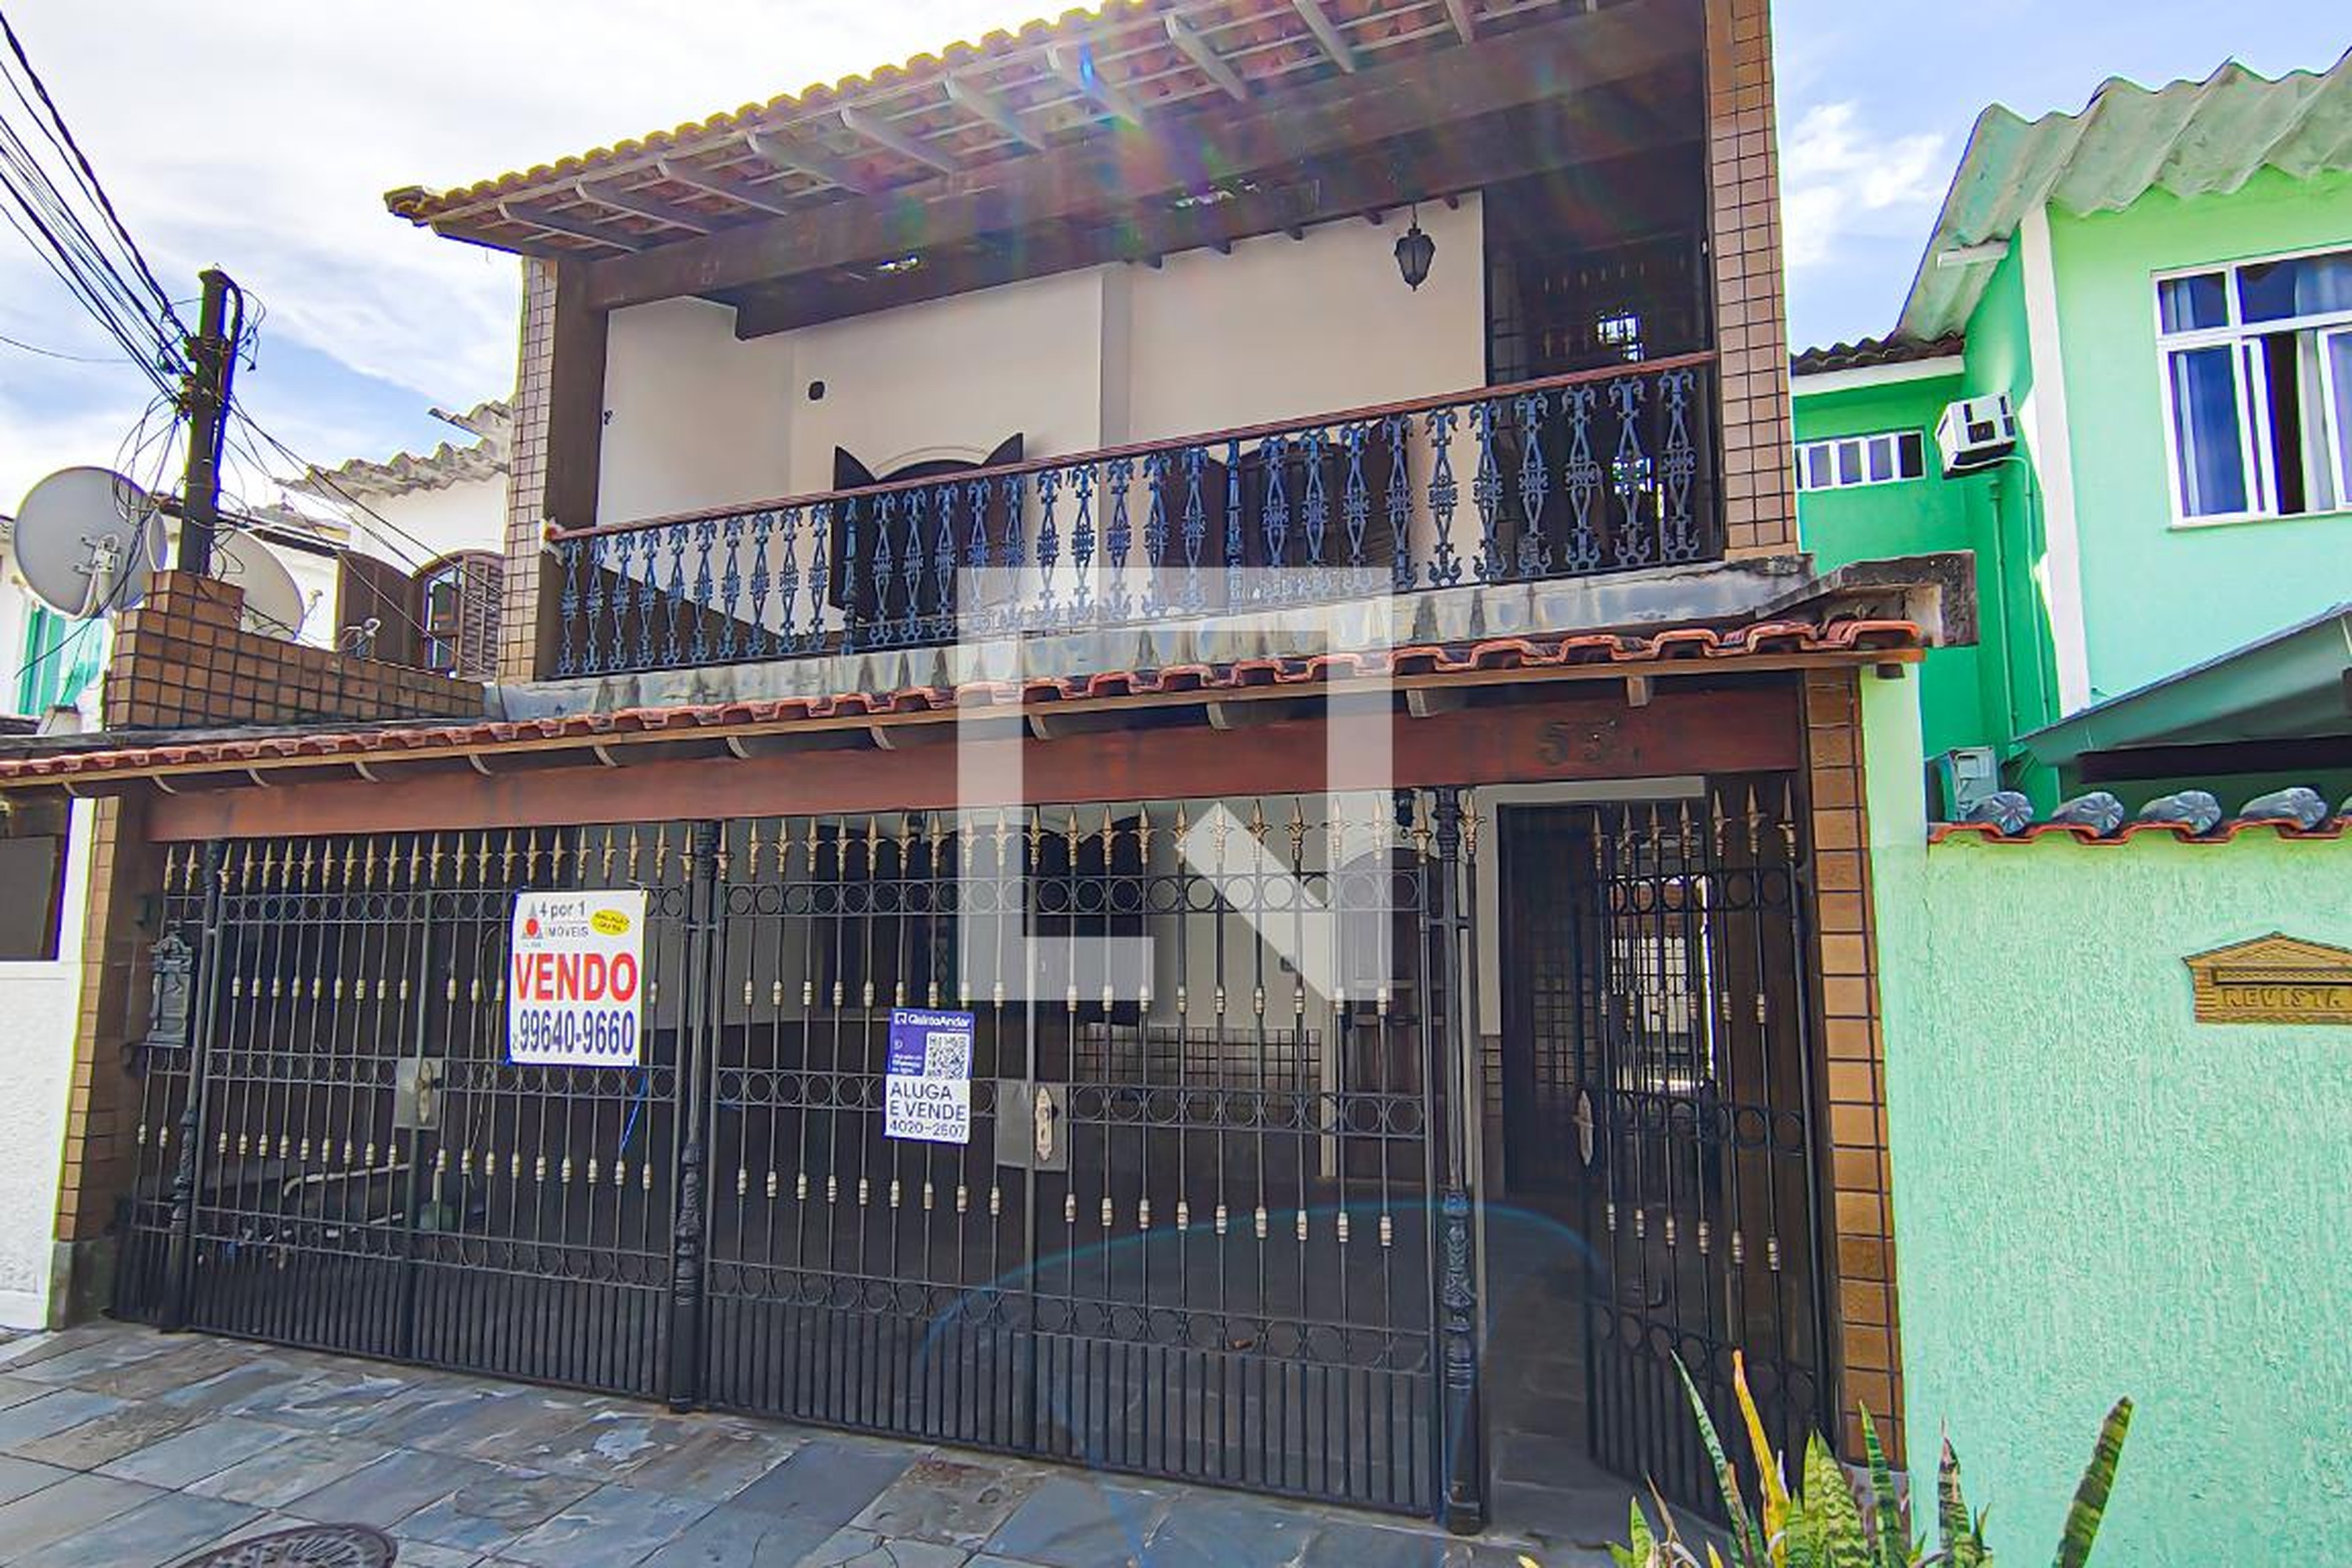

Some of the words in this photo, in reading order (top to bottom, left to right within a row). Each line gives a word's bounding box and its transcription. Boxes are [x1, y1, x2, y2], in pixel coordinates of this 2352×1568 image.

[540, 901, 548, 917] 4
[551, 904, 573, 920] por
[578, 900, 585, 916] 1
[514, 952, 638, 1001] VENDO
[520, 1009, 635, 1055] 99640-9660
[890, 1082, 952, 1100] ALUGA
[890, 1100, 899, 1116] E
[905, 1102, 967, 1121] VENDE
